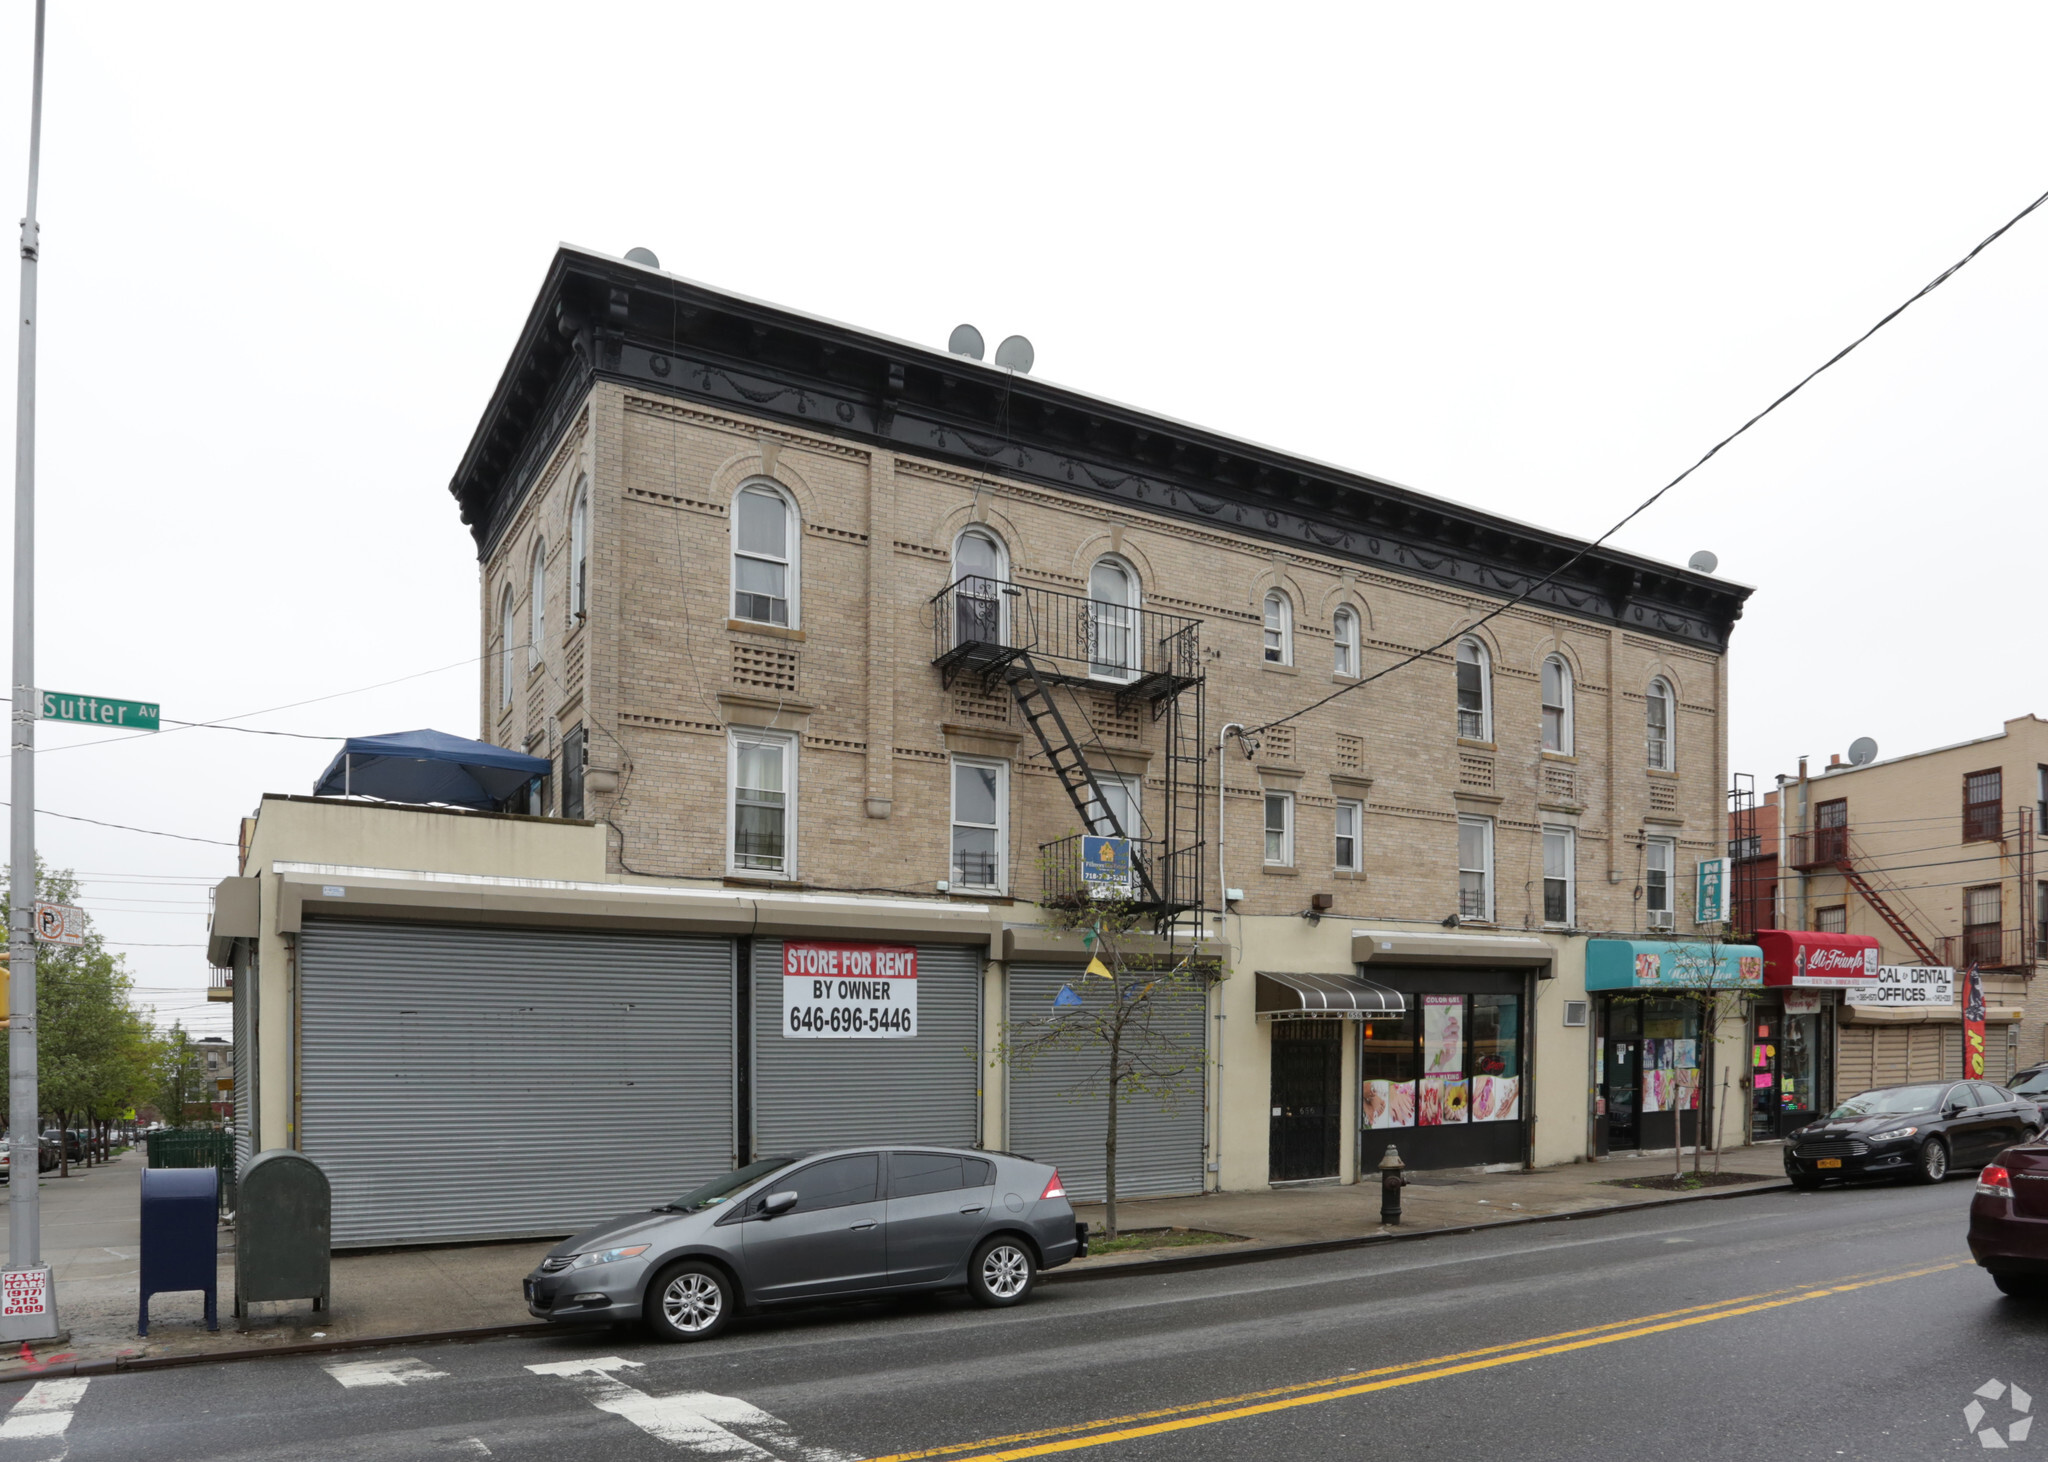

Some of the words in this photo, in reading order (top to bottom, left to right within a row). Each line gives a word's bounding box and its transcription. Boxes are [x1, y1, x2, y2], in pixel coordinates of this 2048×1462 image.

[44, 694, 127, 724] Sutter
[138, 705, 158, 718] Av
[1703, 862, 1719, 919] NAILS
[787, 948, 838, 974] STORE
[842, 951, 872, 975] FOR
[876, 952, 914, 976] RENT
[1807, 949, 1828, 970] Mi
[1878, 968, 1900, 983] CAL
[1911, 969, 1951, 984] DENTAL
[813, 980, 833, 999] BY
[838, 980, 891, 1000] OWNER
[1878, 987, 1926, 1002] OFFICES
[790, 1006, 911, 1032] 646-696-5446
[7, 1289, 42, 1297] (917)
[11, 1297, 38, 1305] 515
[5, 1305, 43, 1314] 6499
